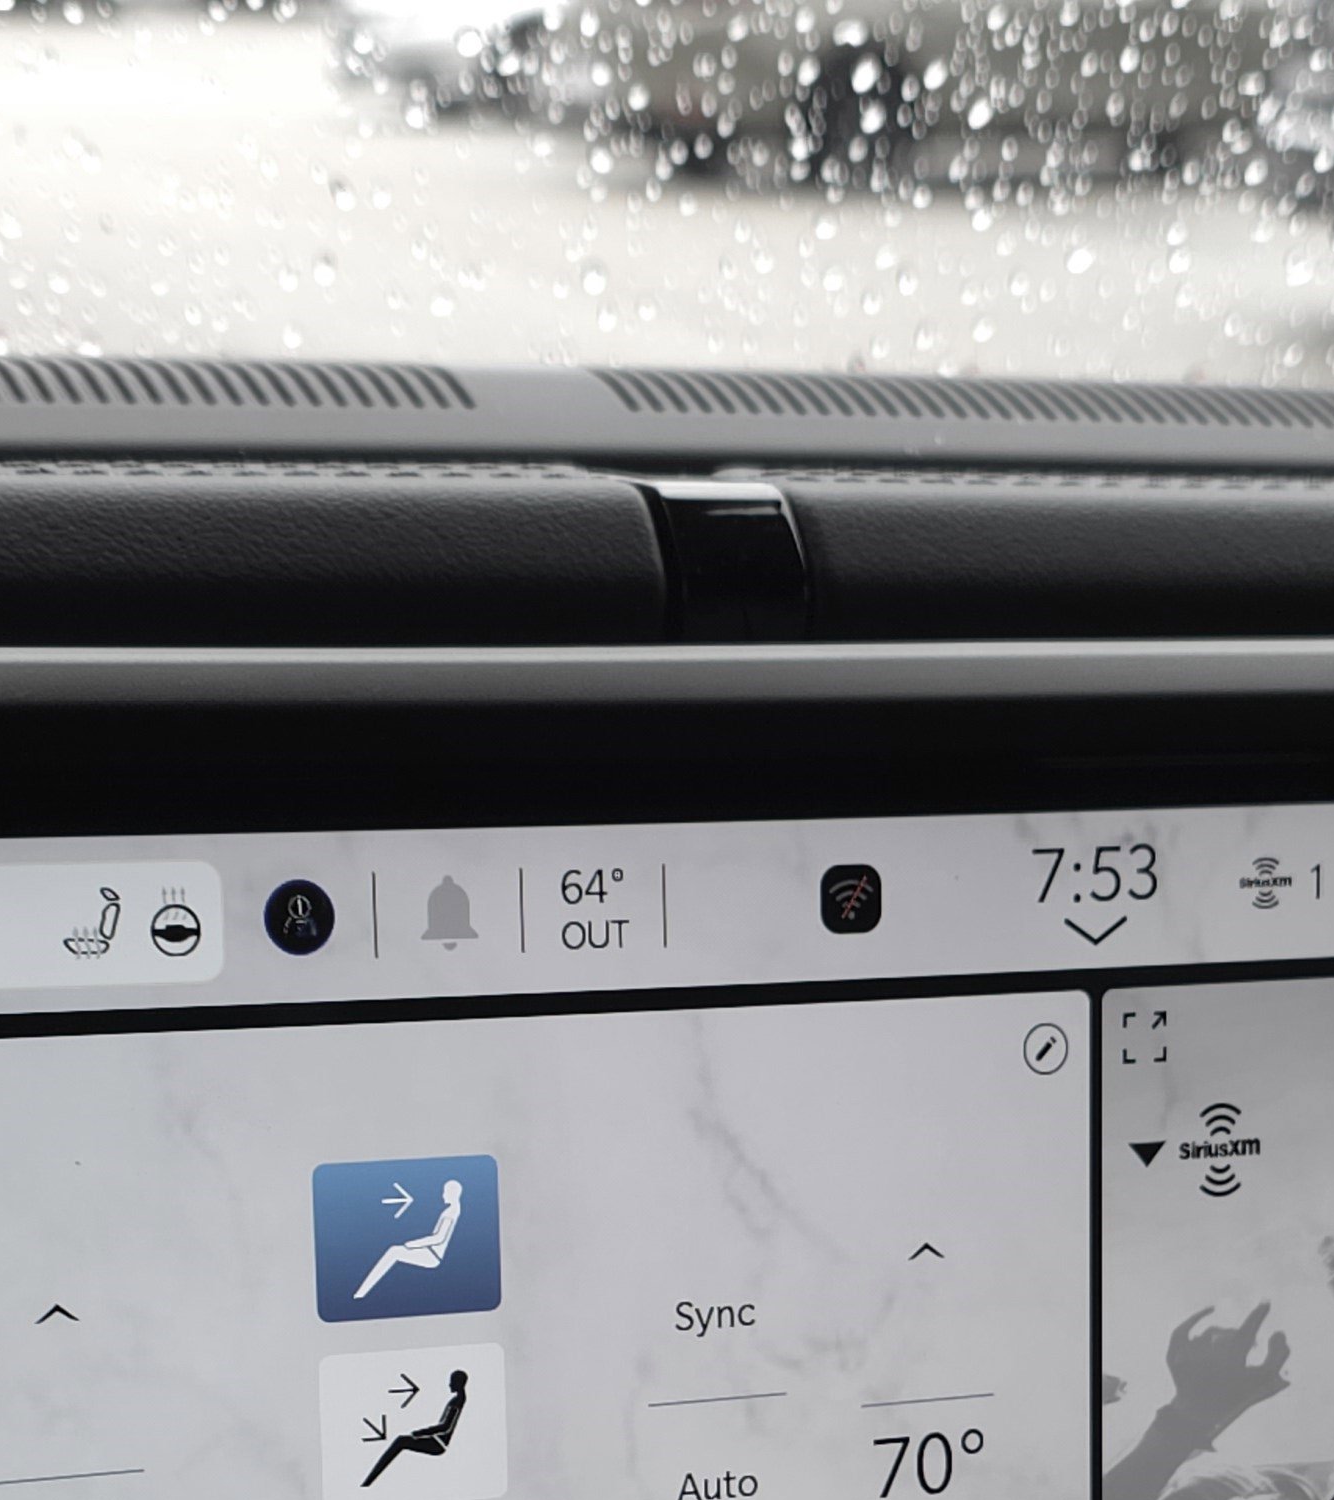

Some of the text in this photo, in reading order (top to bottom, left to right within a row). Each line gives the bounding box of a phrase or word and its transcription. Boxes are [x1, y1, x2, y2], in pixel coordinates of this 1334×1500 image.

[561, 867, 625, 905] 64°
[1031, 843, 1158, 903] 7:53
[1310, 863, 1321, 900] 1
[561, 919, 630, 950] OUT
[674, 1300, 757, 1338] Sync
[873, 1428, 985, 1499] 70°
